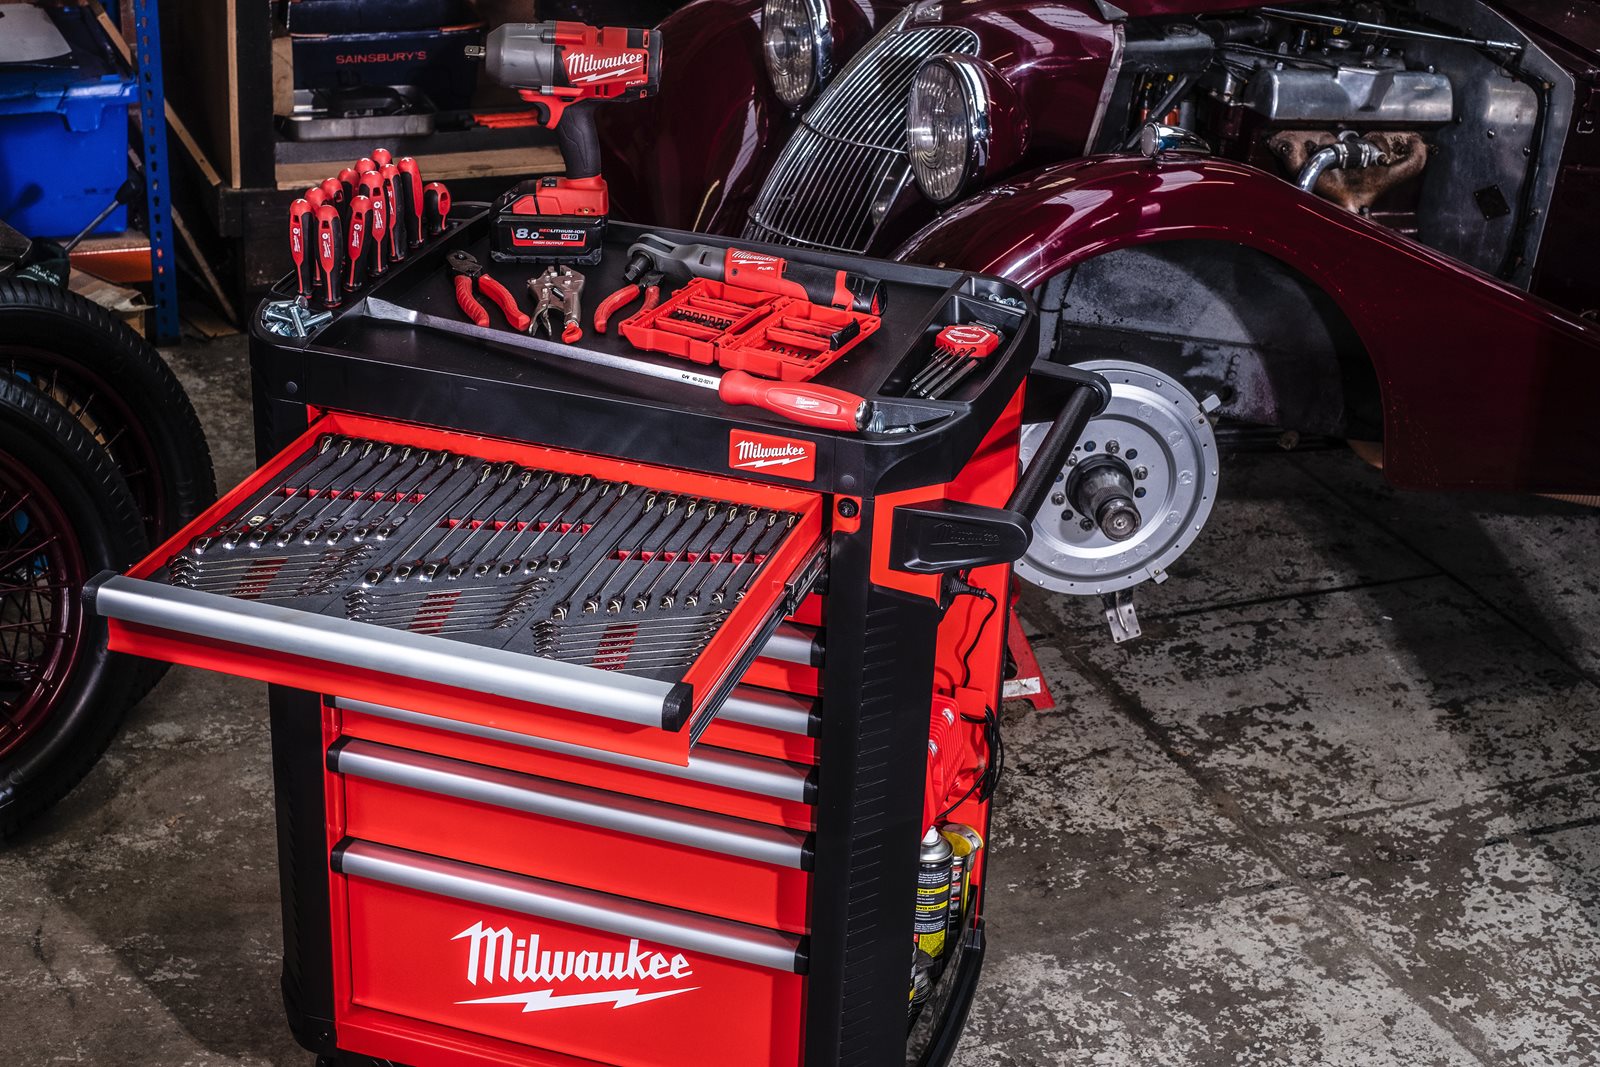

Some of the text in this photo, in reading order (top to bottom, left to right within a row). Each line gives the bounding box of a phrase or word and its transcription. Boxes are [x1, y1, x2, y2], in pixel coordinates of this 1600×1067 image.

[335, 51, 427, 64] SAINSBURY'S
[566, 51, 643, 76] Milwaukee
[515, 227, 540, 240] 8.0
[734, 439, 806, 461] Milwaukee
[450, 920, 694, 986] Milwaukee
